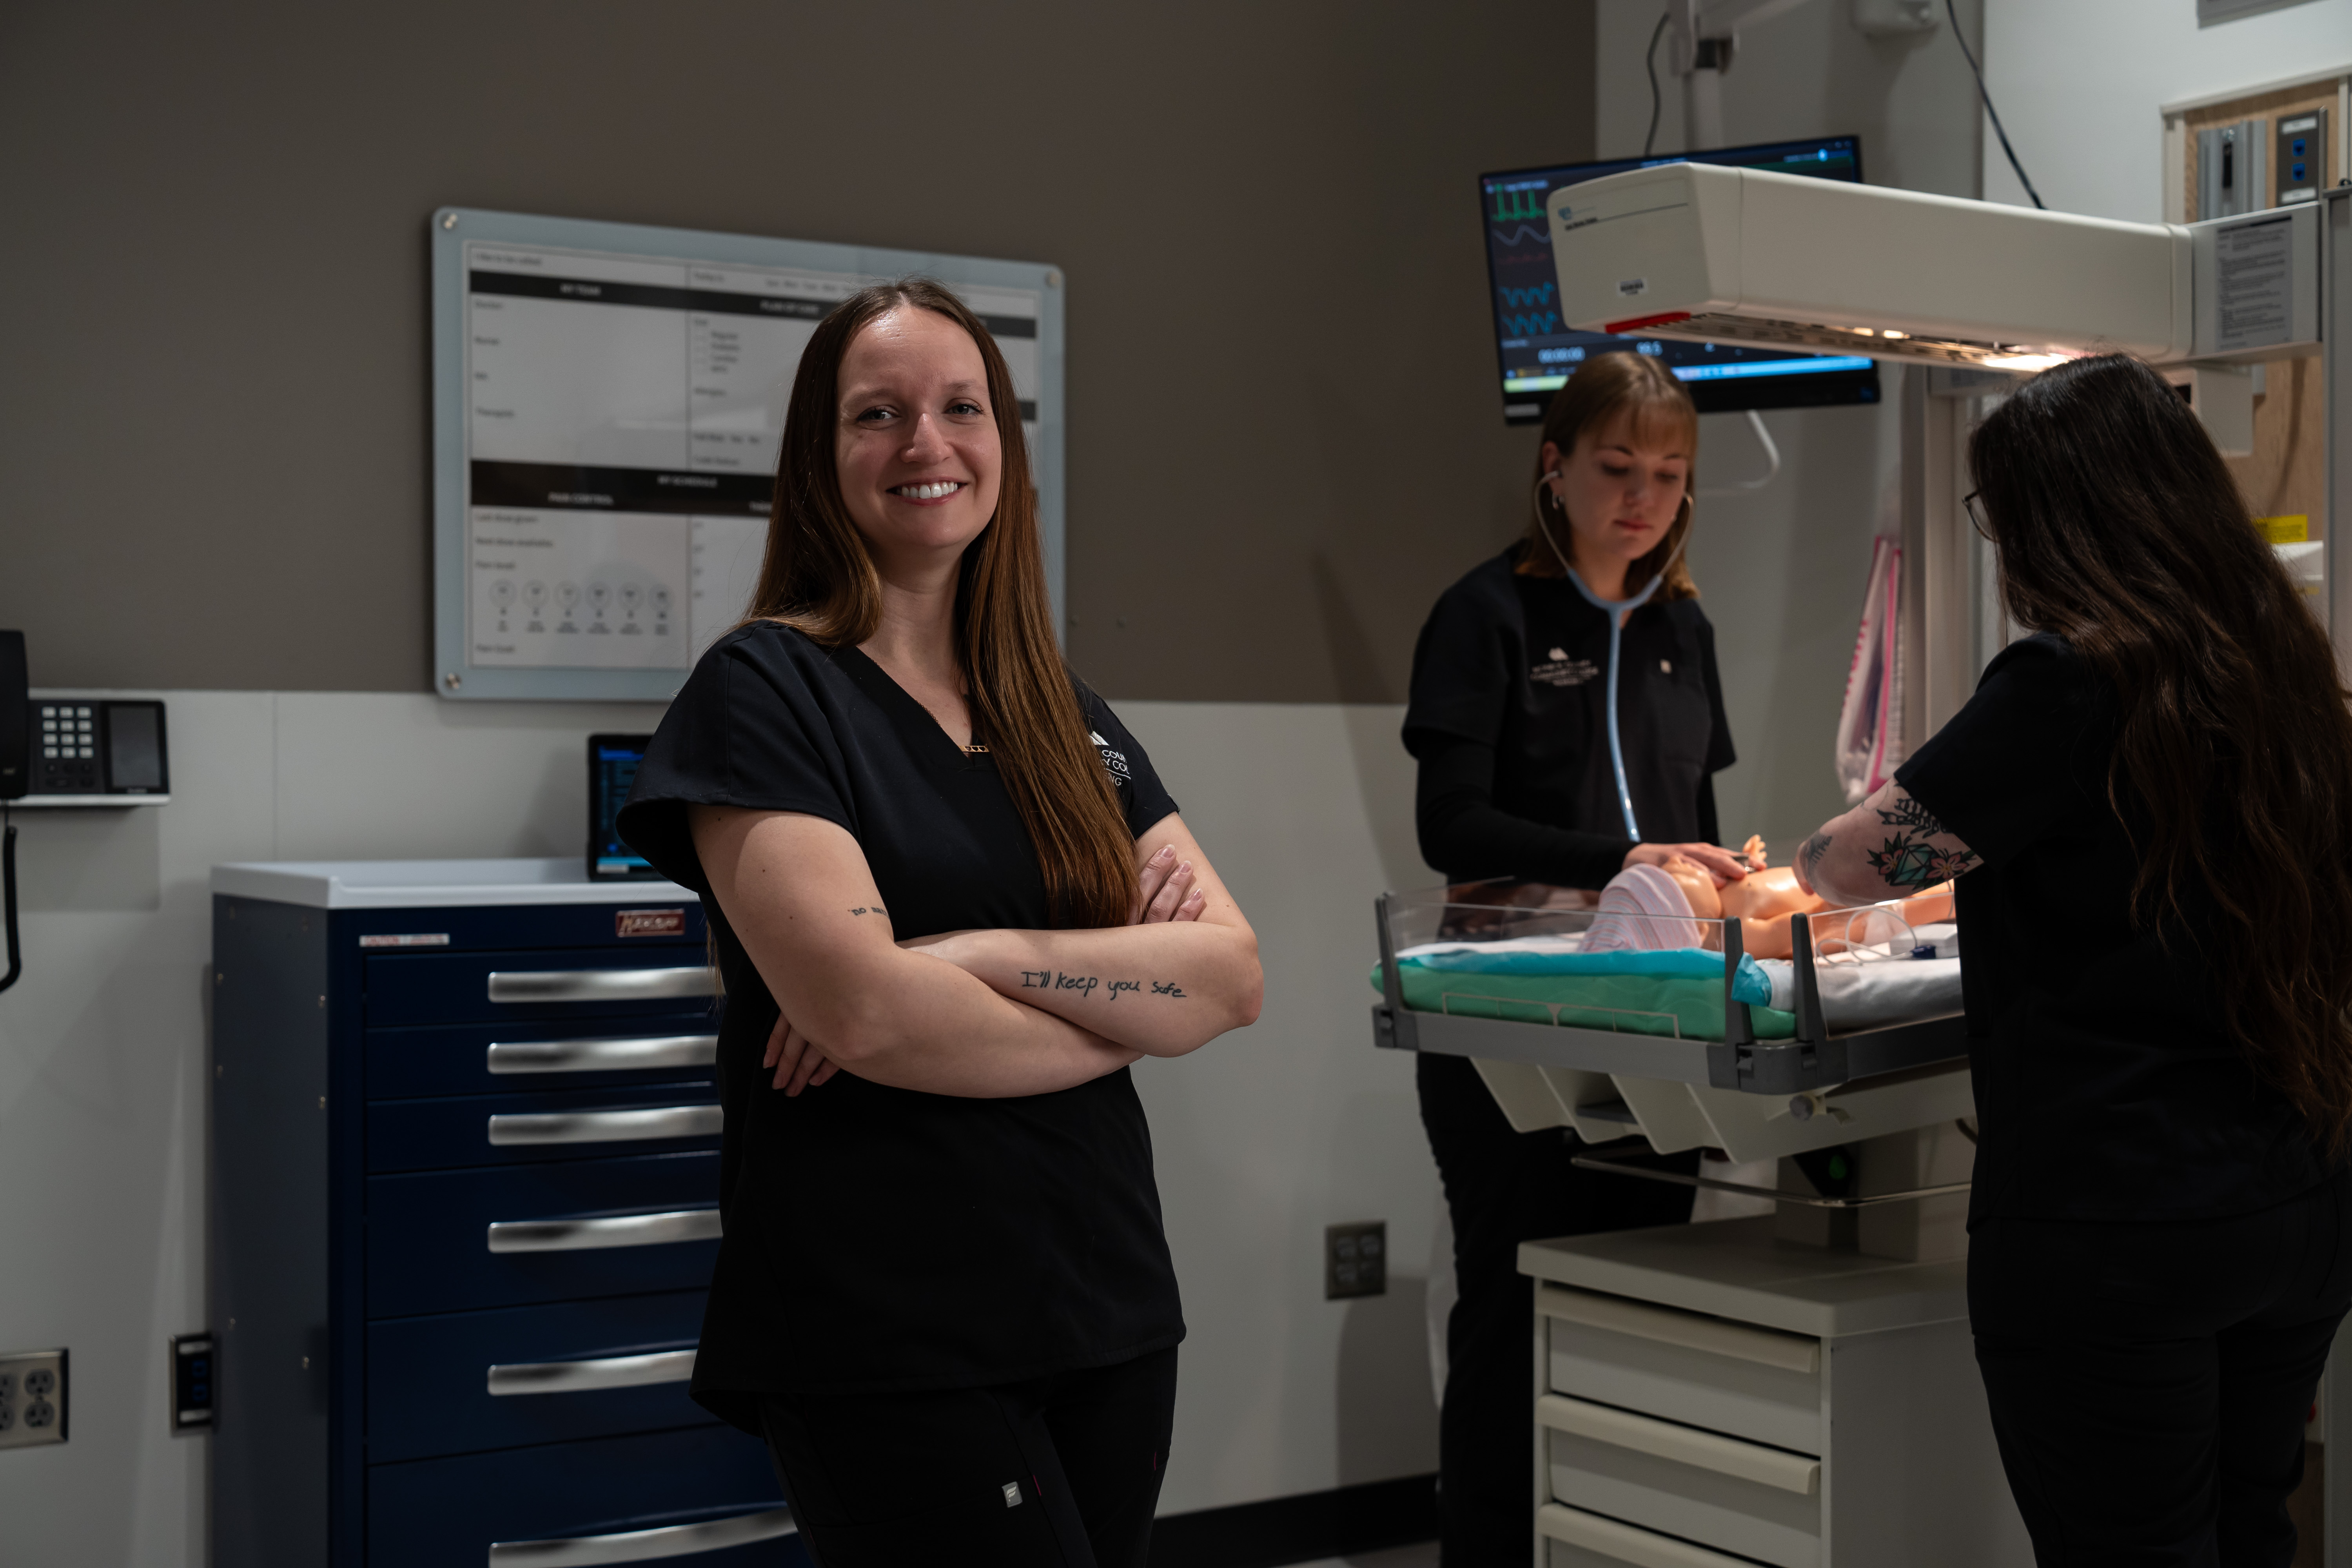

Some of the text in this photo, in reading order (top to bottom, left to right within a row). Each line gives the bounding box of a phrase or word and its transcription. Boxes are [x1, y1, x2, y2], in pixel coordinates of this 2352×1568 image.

[851, 907, 866, 916] no
[1020, 970, 1187, 1001] I'll keep you safe
